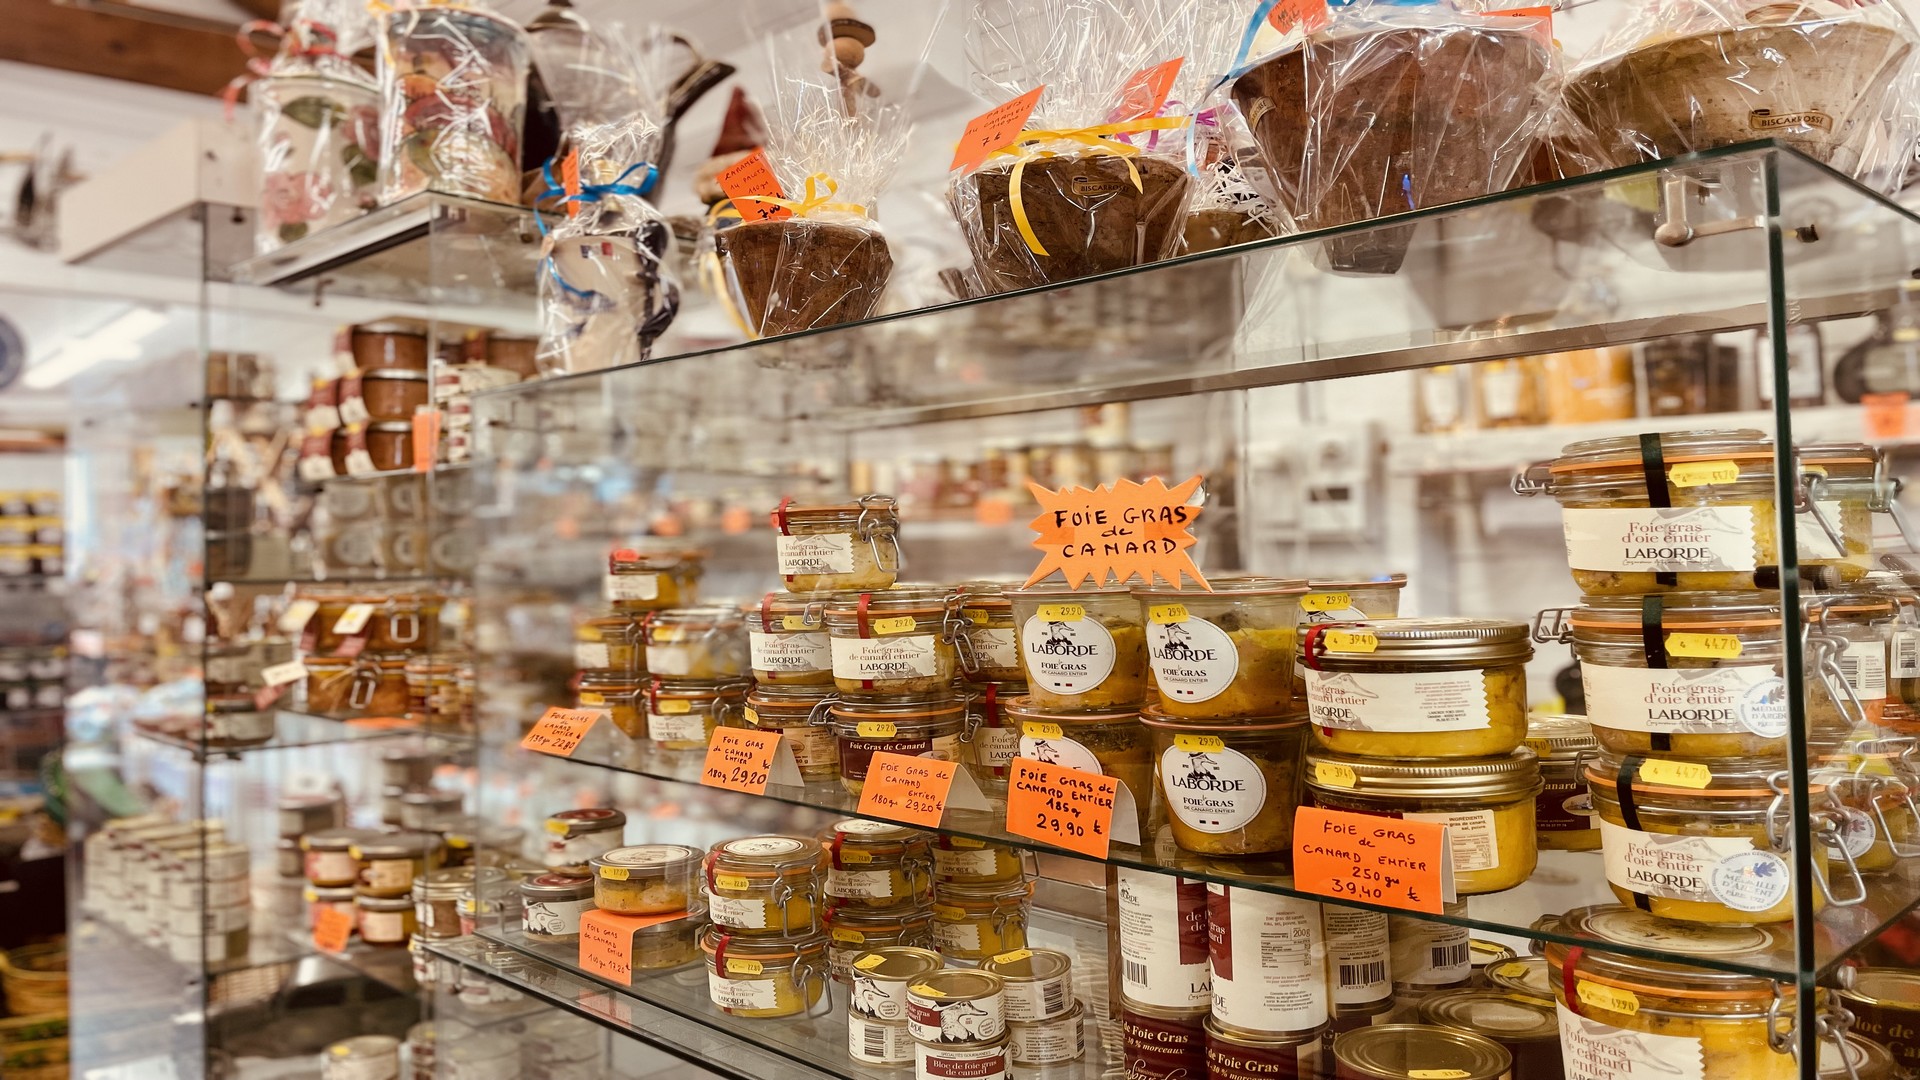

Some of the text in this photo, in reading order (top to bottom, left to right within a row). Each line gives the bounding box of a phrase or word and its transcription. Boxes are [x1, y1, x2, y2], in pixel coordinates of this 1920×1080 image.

[1054, 505, 1188, 528] FOIE GRAS
[1101, 525, 1133, 538] de
[1629, 522, 1703, 536] Foie gras
[1621, 532, 1712, 544] d'oie entier
[1062, 537, 1177, 558] CANARD
[1625, 547, 1711, 560] LABORDE
[893, 652, 921, 661] entier
[1031, 642, 1099, 658] LABORDE
[1153, 646, 1218, 663] LABORDE
[763, 656, 804, 665] LABORDE
[860, 662, 909, 671] LABORDE
[1041, 661, 1087, 671] FOIE GRAS
[1162, 667, 1207, 677] FOIE GRAS
[1651, 682, 1726, 696] Foie gras
[1335, 695, 1368, 706] entier
[1644, 692, 1735, 704] d'oie entier
[1311, 703, 1353, 720] LABORDE
[1648, 708, 1735, 722] LABORDE
[722, 736, 739, 746] FOIE
[849, 741, 926, 751] Foie Gras de Canard
[880, 762, 949, 780] FOIE GRAS de
[885, 775, 921, 789] CANARD
[1020, 768, 1115, 794] FOIE GRAS de
[1171, 774, 1246, 793] LABORDE
[1544, 782, 1577, 790] anard
[1016, 781, 1113, 810] CANARD ENTIER
[1183, 796, 1234, 808] FOIE GRAS
[905, 798, 934, 813] 29,20
[1036, 813, 1084, 837] 29,90
[1323, 820, 1416, 845] FOIE GRAS
[1358, 837, 1376, 848] de
[1302, 844, 1427, 872] CANARD ENTIER
[1628, 842, 1694, 862] Foie gras
[1623, 852, 1704, 873] d'oie entier
[1627, 866, 1704, 889] LABORDE
[1331, 878, 1382, 899] 39,40
[1185, 911, 1202, 922] de
[1132, 1025, 1154, 1040] Foie
[1157, 1031, 1189, 1043] Gras
[1855, 1016, 1914, 1039] loc de
[1142, 1043, 1185, 1055] morceaux
[1591, 1041, 1627, 1058] gras
[933, 1060, 997, 1070] Bloc de foie gras
[1218, 1053, 1241, 1069] Foie
[1245, 1060, 1279, 1073] Gras
[1576, 1047, 1632, 1074] canard
[945, 1066, 987, 1076] de canard
[1572, 1058, 1615, 1080] entier
